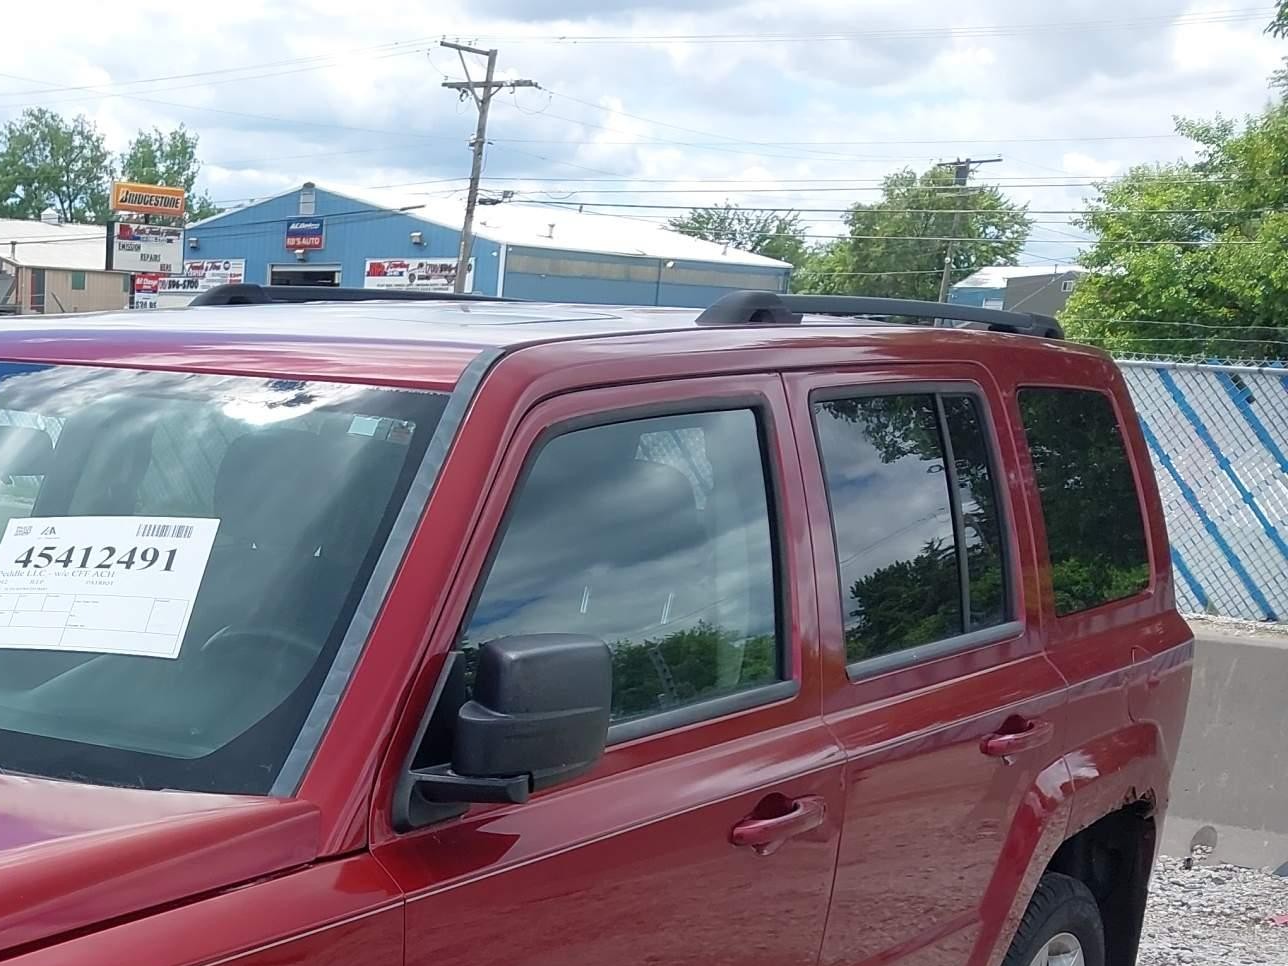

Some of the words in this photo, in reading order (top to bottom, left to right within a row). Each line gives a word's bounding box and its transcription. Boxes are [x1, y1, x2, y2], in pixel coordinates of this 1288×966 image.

[119, 190, 182, 209] BRIDGESTONE
[302, 237, 321, 246] AUTO
[140, 253, 161, 263] REPAIRS
[14, 545, 178, 572] 45412491
